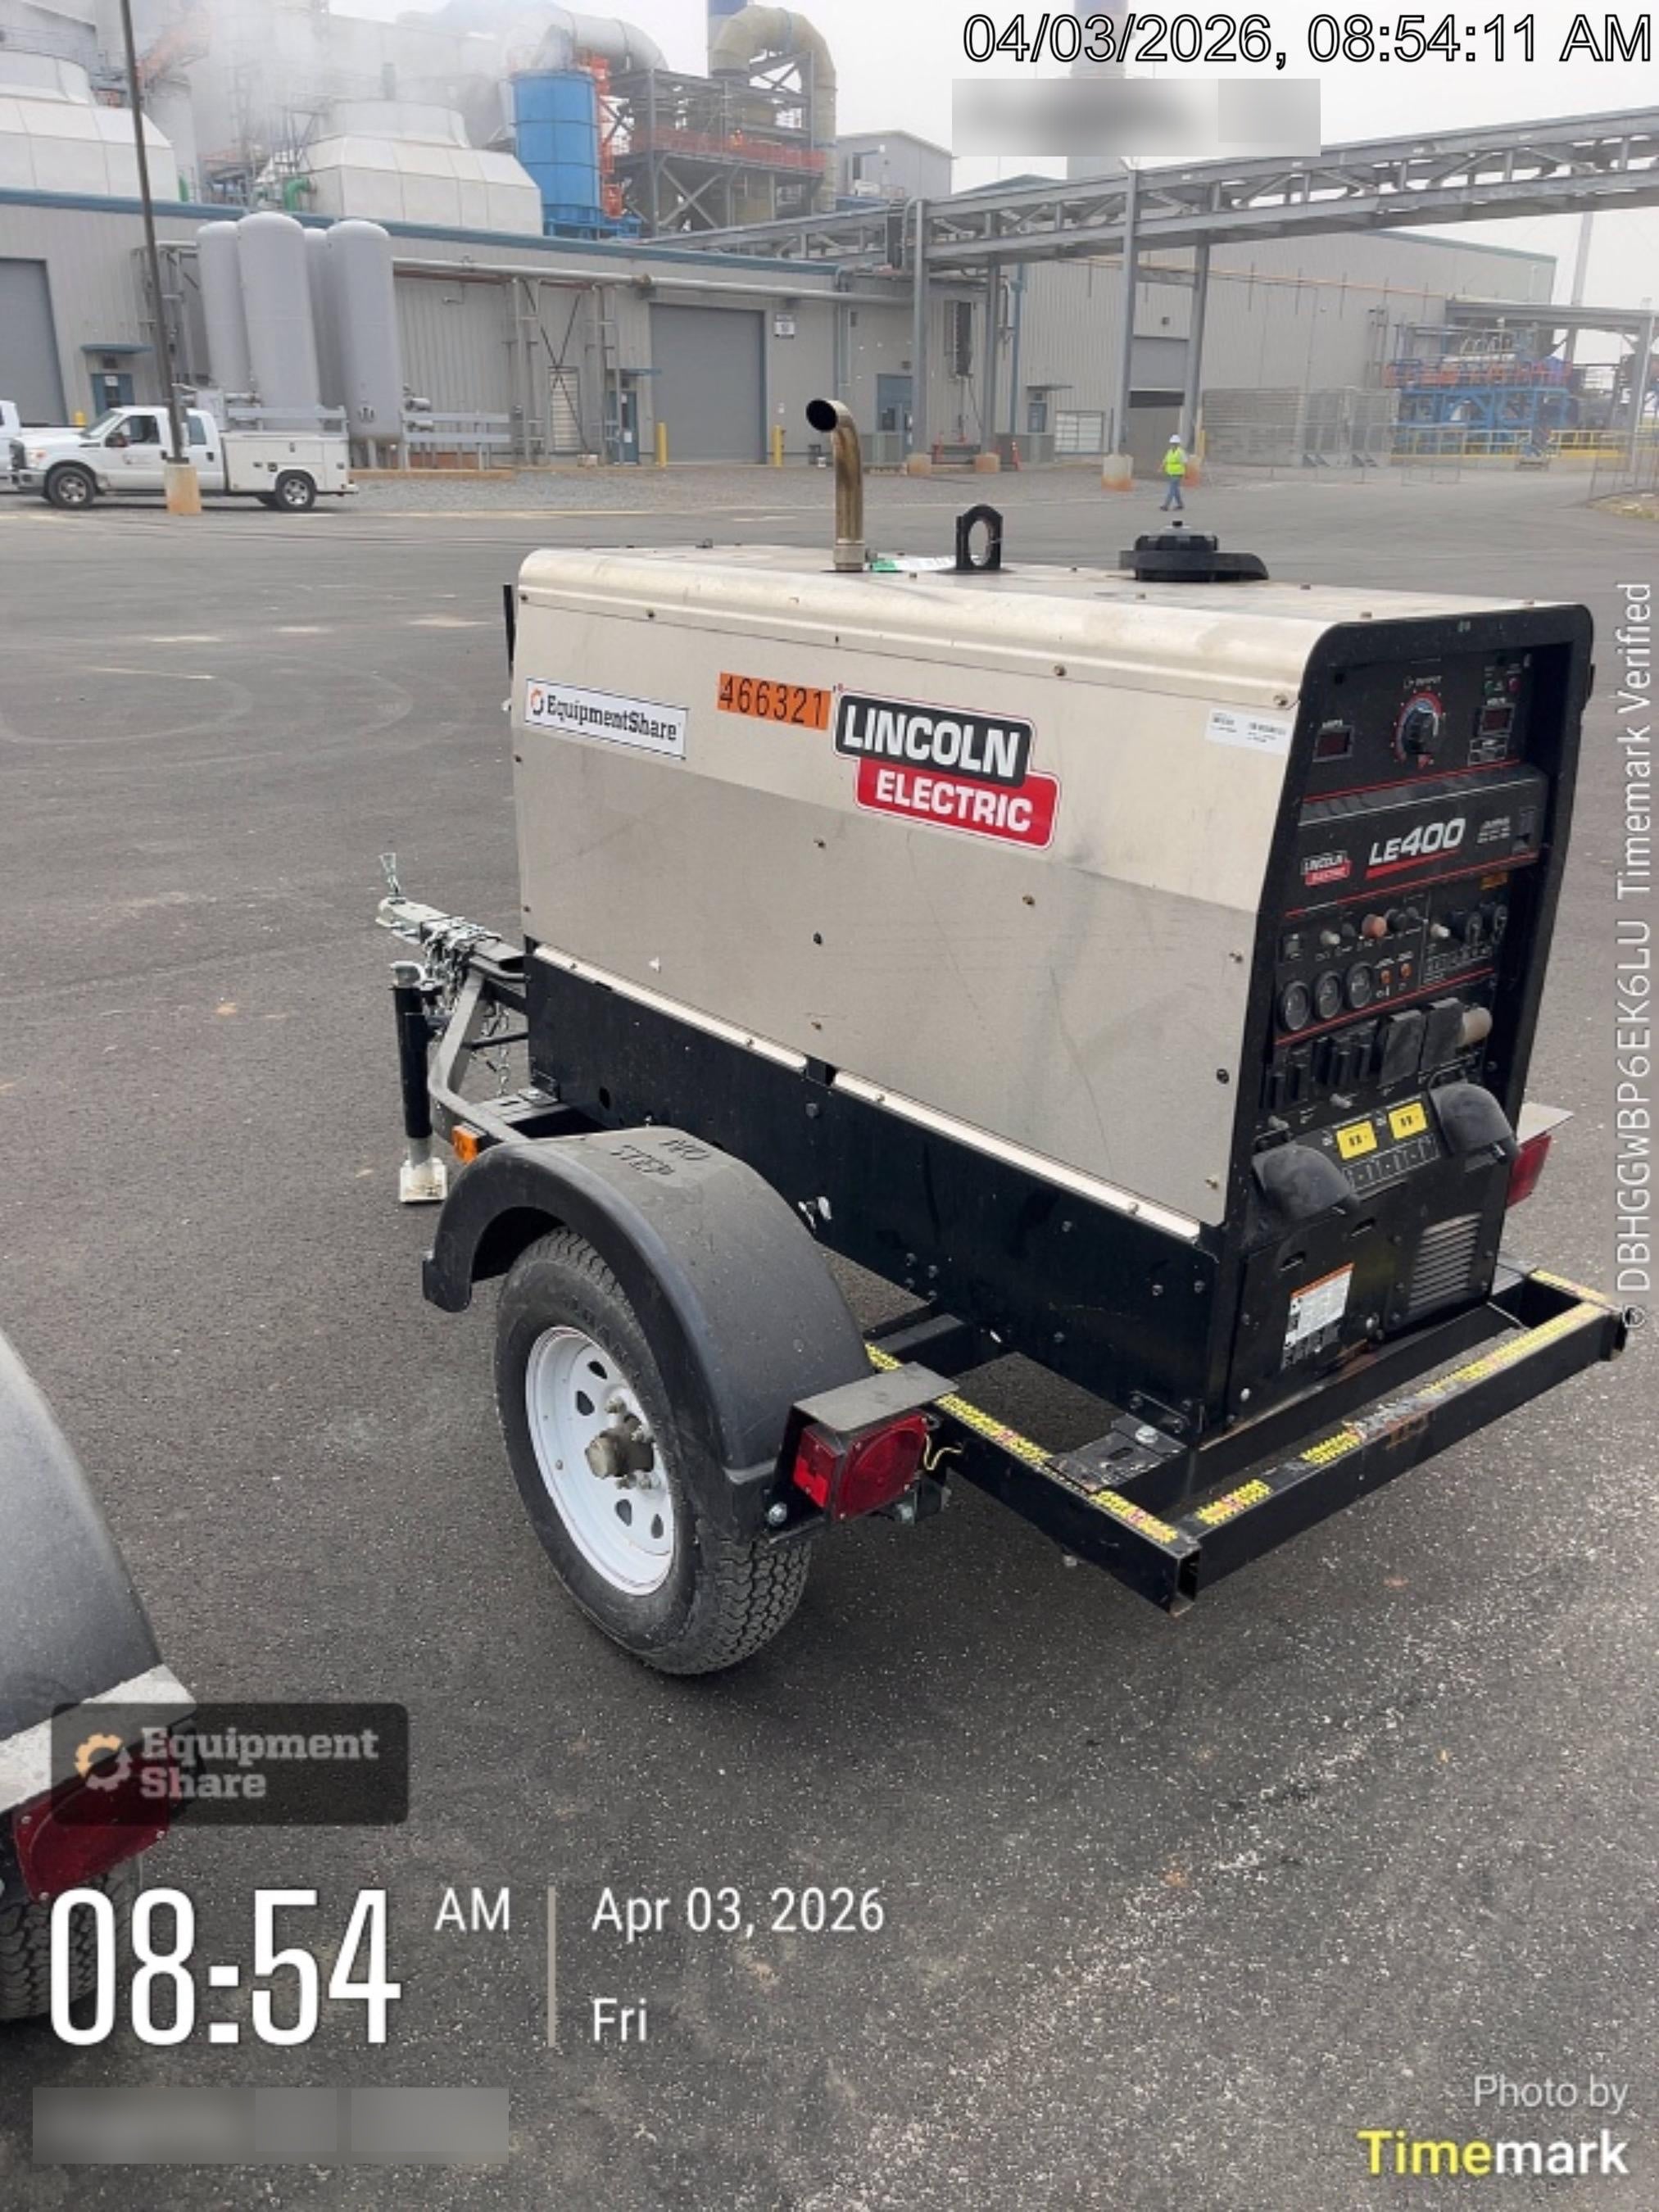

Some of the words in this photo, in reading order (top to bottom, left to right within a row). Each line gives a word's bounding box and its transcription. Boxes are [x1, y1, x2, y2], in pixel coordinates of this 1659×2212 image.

[547, 694, 677, 741] EquipmentShare
[720, 675, 823, 726] 466321
[843, 705, 1021, 778] LINCOLN
[875, 768, 1033, 832] ELECTRIC
[1369, 818, 1466, 866] LE400
